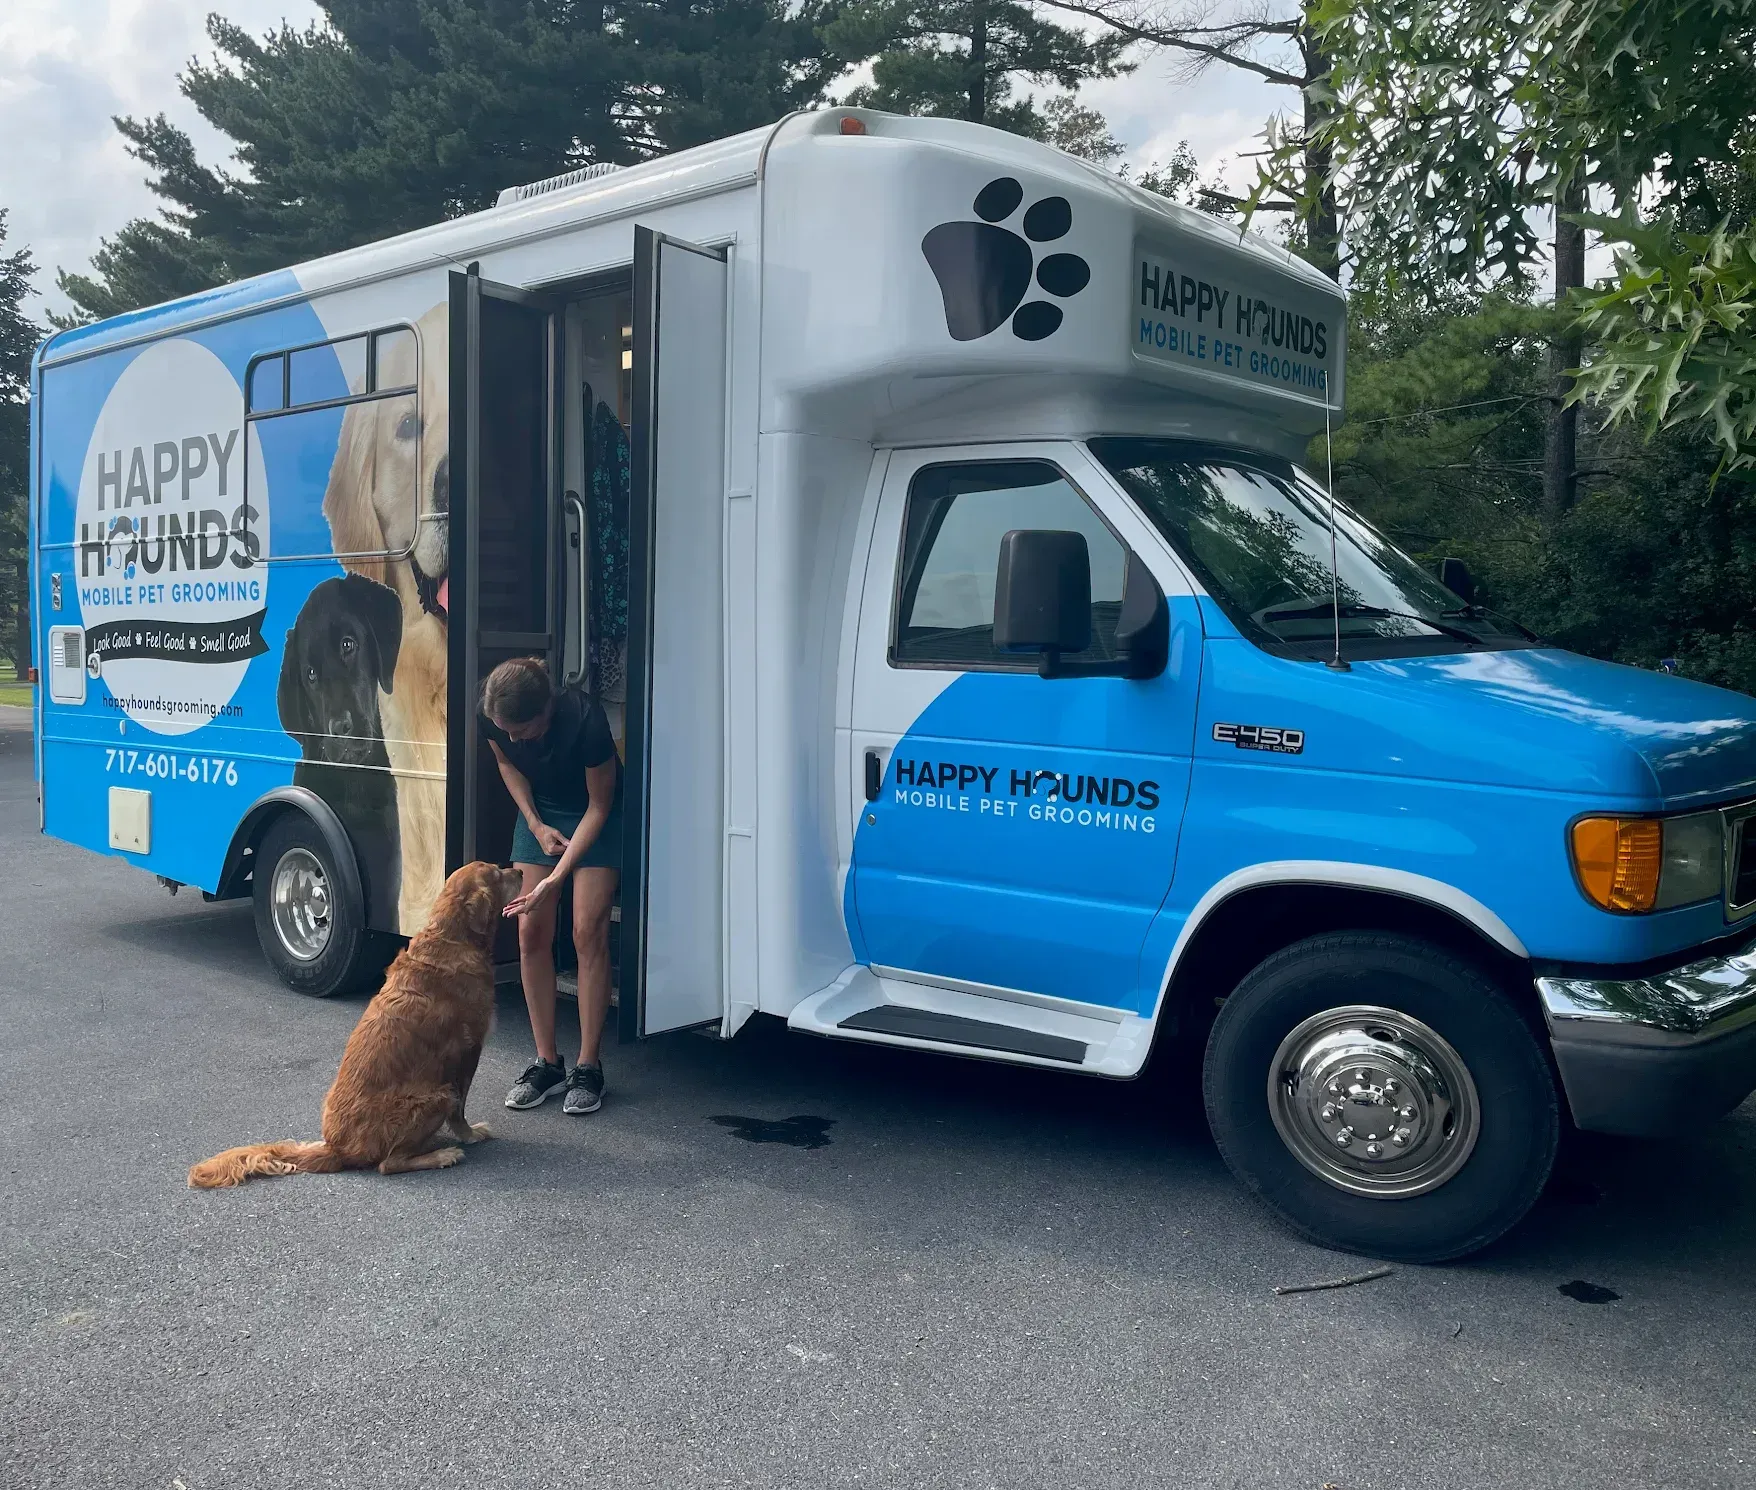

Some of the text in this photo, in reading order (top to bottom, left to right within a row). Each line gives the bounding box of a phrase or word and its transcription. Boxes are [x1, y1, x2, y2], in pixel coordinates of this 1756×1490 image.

[1141, 261, 1328, 360] HAPPY HOUNDS
[1140, 317, 1327, 391] MOBILE PET GROOMING
[97, 428, 240, 511] HAPPY
[81, 503, 260, 578] HOUNDS
[82, 580, 260, 607] MOBILE PET GROOMING
[93, 626, 251, 653] Look Good Feel Good Smell Good
[102, 693, 244, 719] happyhoundsgrooming.com
[105, 748, 239, 787] 717-601-6176
[1239, 741, 1300, 754] SUPER DUTY
[896, 758, 1161, 811] HAPPY HOUNDS
[895, 789, 1156, 834] MOBILE PET GROOMING
